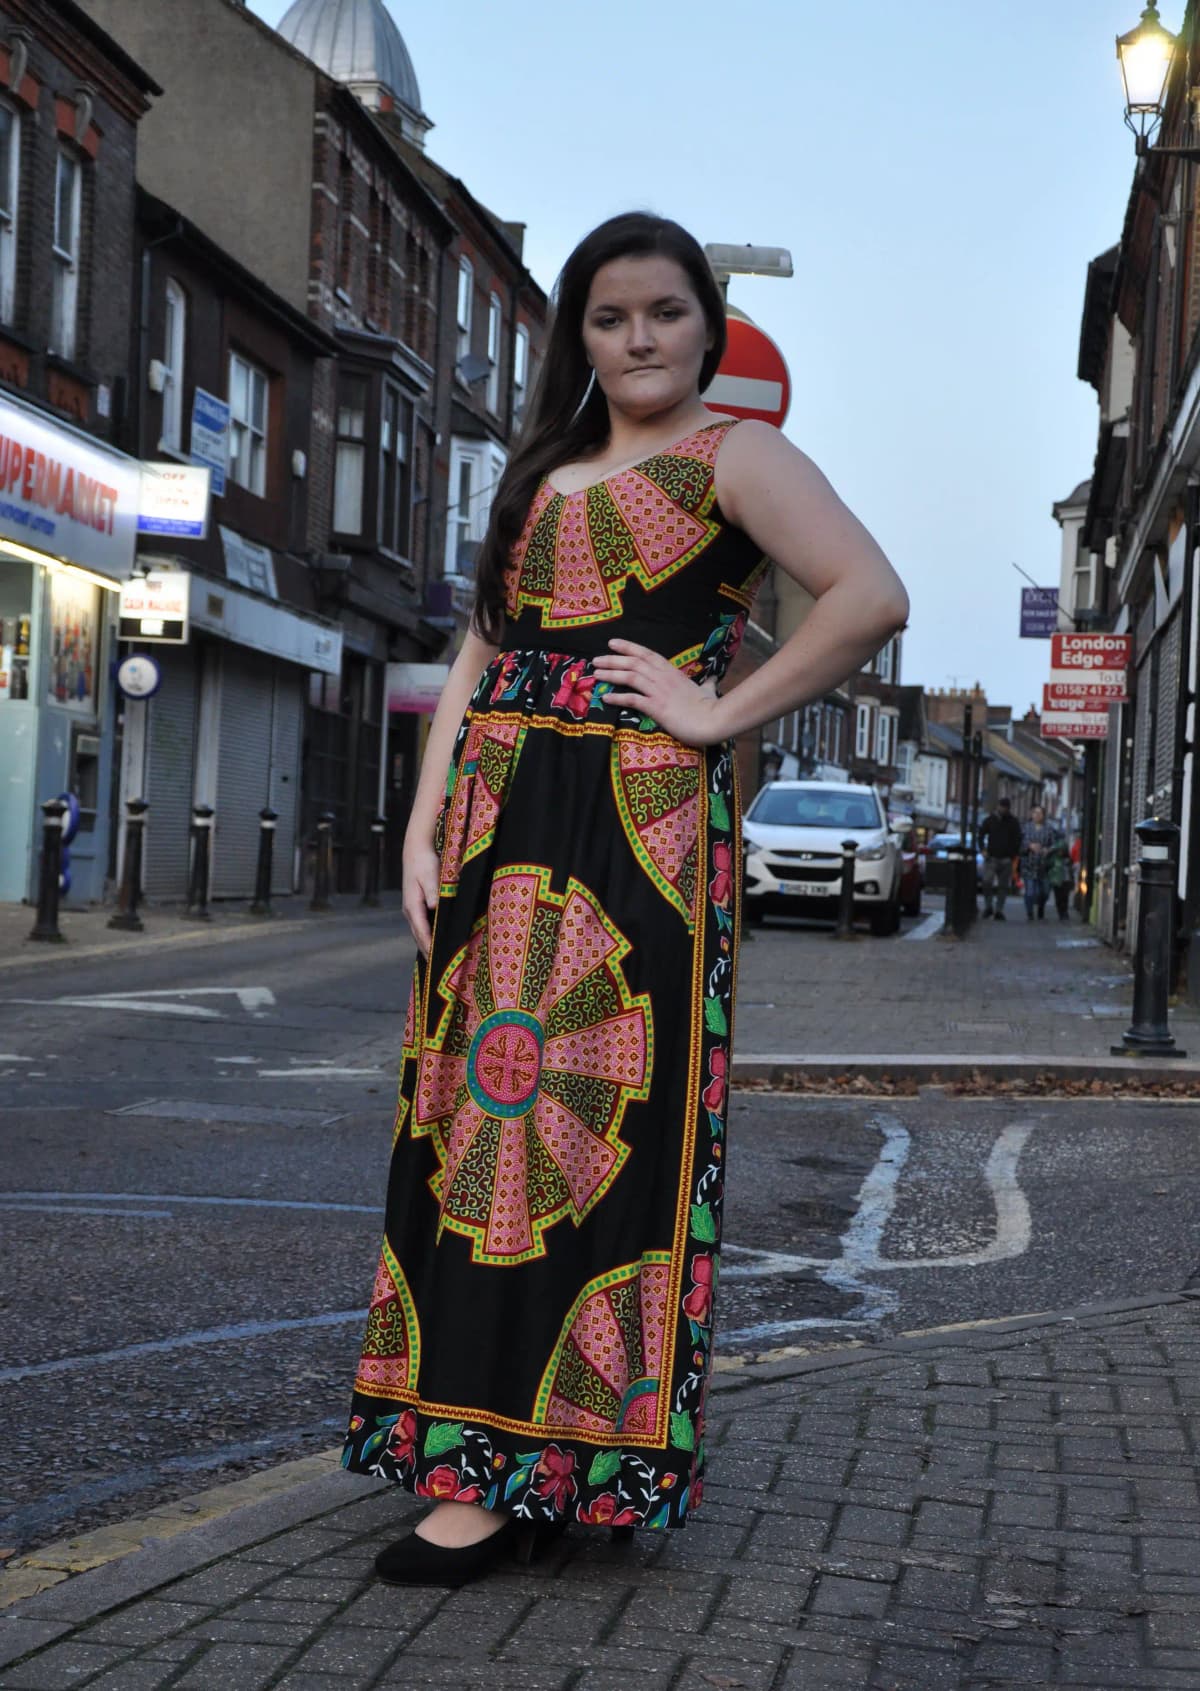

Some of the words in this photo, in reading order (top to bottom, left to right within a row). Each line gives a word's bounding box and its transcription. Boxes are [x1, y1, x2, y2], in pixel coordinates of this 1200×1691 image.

[1061, 636, 1126, 650] London
[1061, 651, 1104, 668] Edge
[1098, 671, 1113, 682] To
[1056, 685, 1088, 695] 01582
[1089, 686, 1102, 695] 41
[1104, 687, 1118, 697] 22
